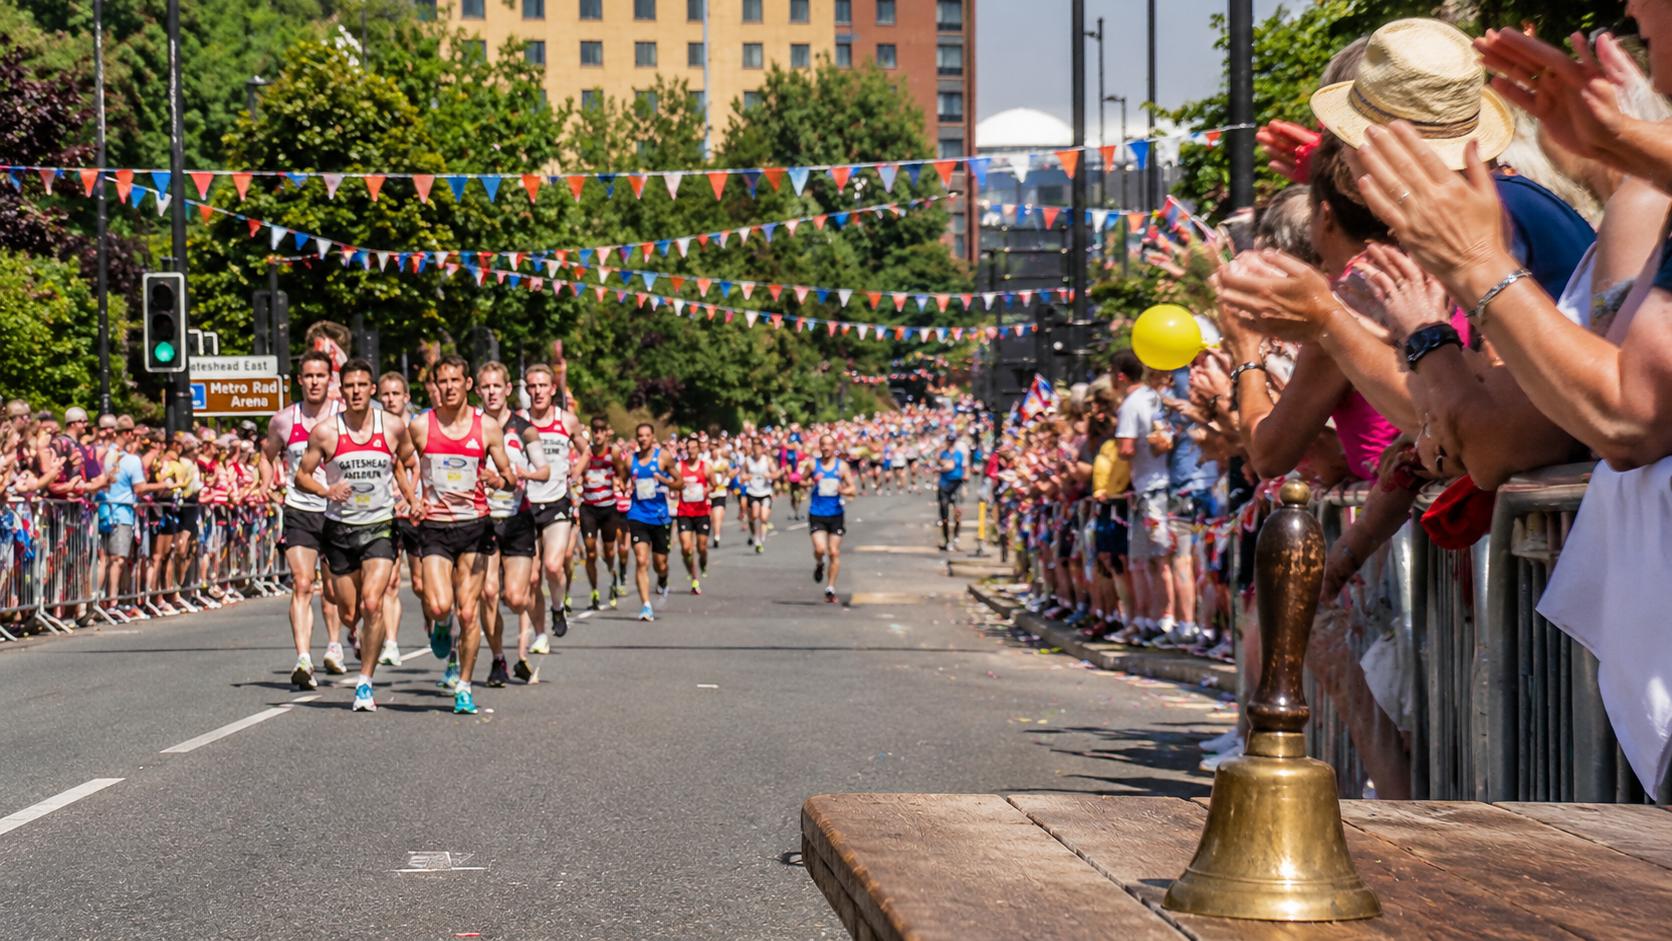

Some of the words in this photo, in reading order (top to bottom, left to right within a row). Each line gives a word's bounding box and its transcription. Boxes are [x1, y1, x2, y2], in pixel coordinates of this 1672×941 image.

[244, 361, 267, 371] East
[210, 381, 248, 394] Metro
[230, 395, 269, 408] Arena
